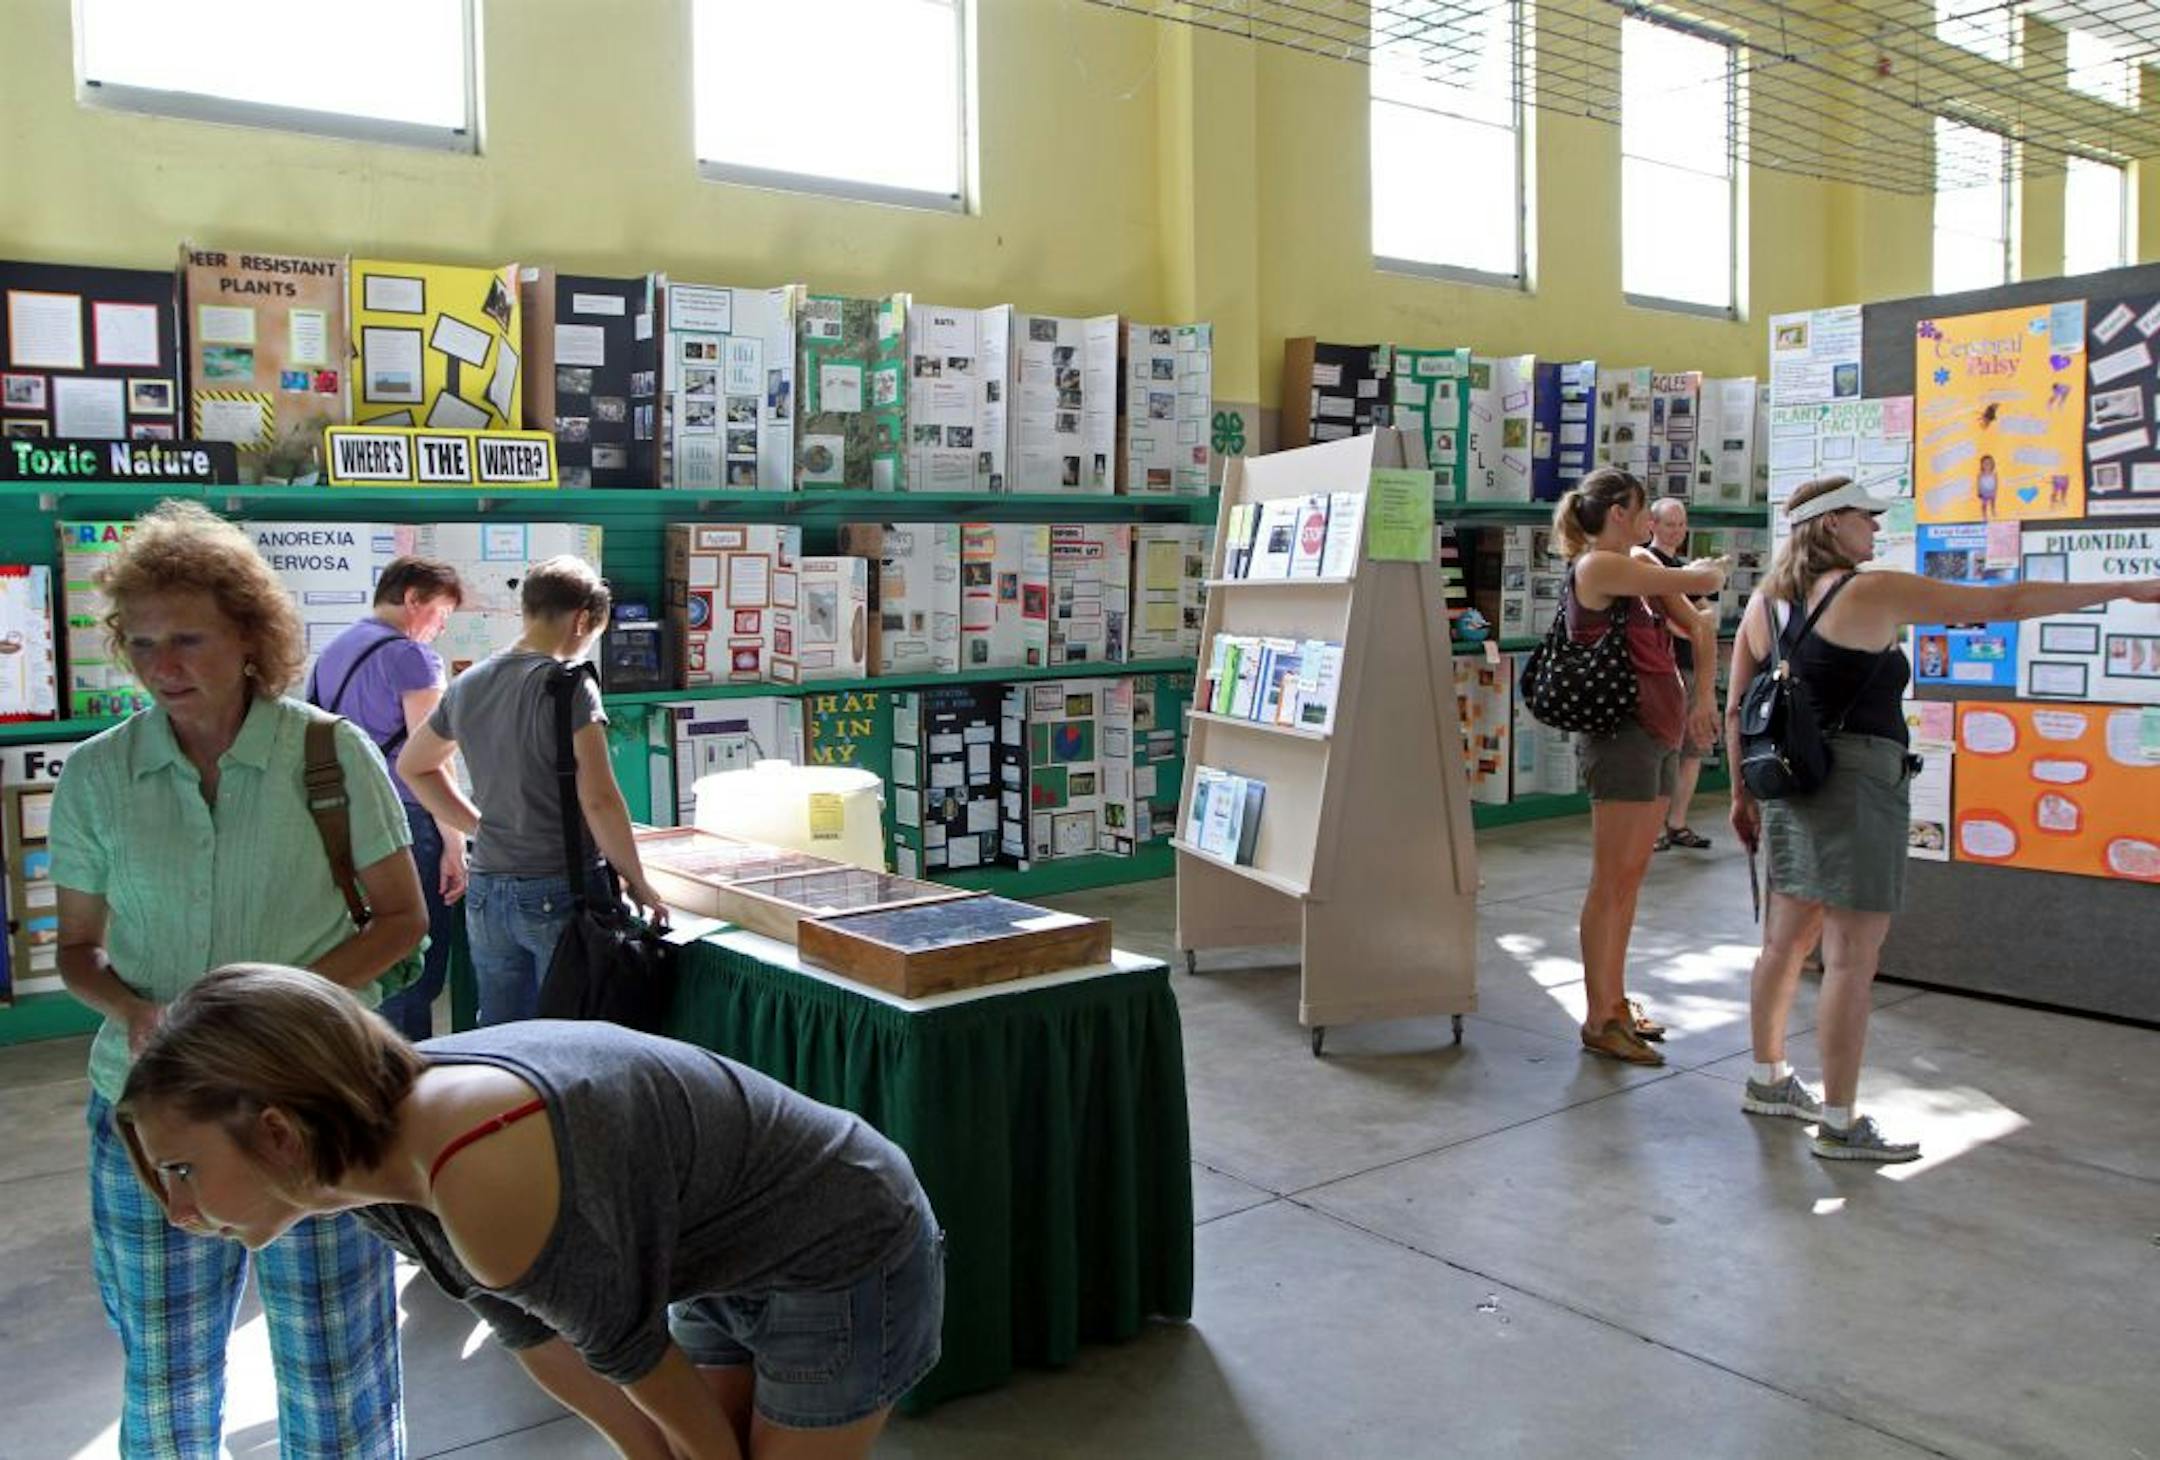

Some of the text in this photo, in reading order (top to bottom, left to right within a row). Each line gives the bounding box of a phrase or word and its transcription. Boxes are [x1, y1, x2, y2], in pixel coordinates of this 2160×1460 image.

[241, 255, 337, 277] RESISTANT
[220, 278, 297, 297] PLANTS
[1966, 354, 2020, 377] Palsy
[12, 441, 210, 475] Toxic Nature
[340, 440, 542, 477] WHERE'S THE WATER?
[258, 531, 354, 546] ANOREXIA
[2046, 532, 2152, 553] PILONIDAL
[266, 554, 349, 570] ERVOSA
[836, 718, 872, 737] IN
